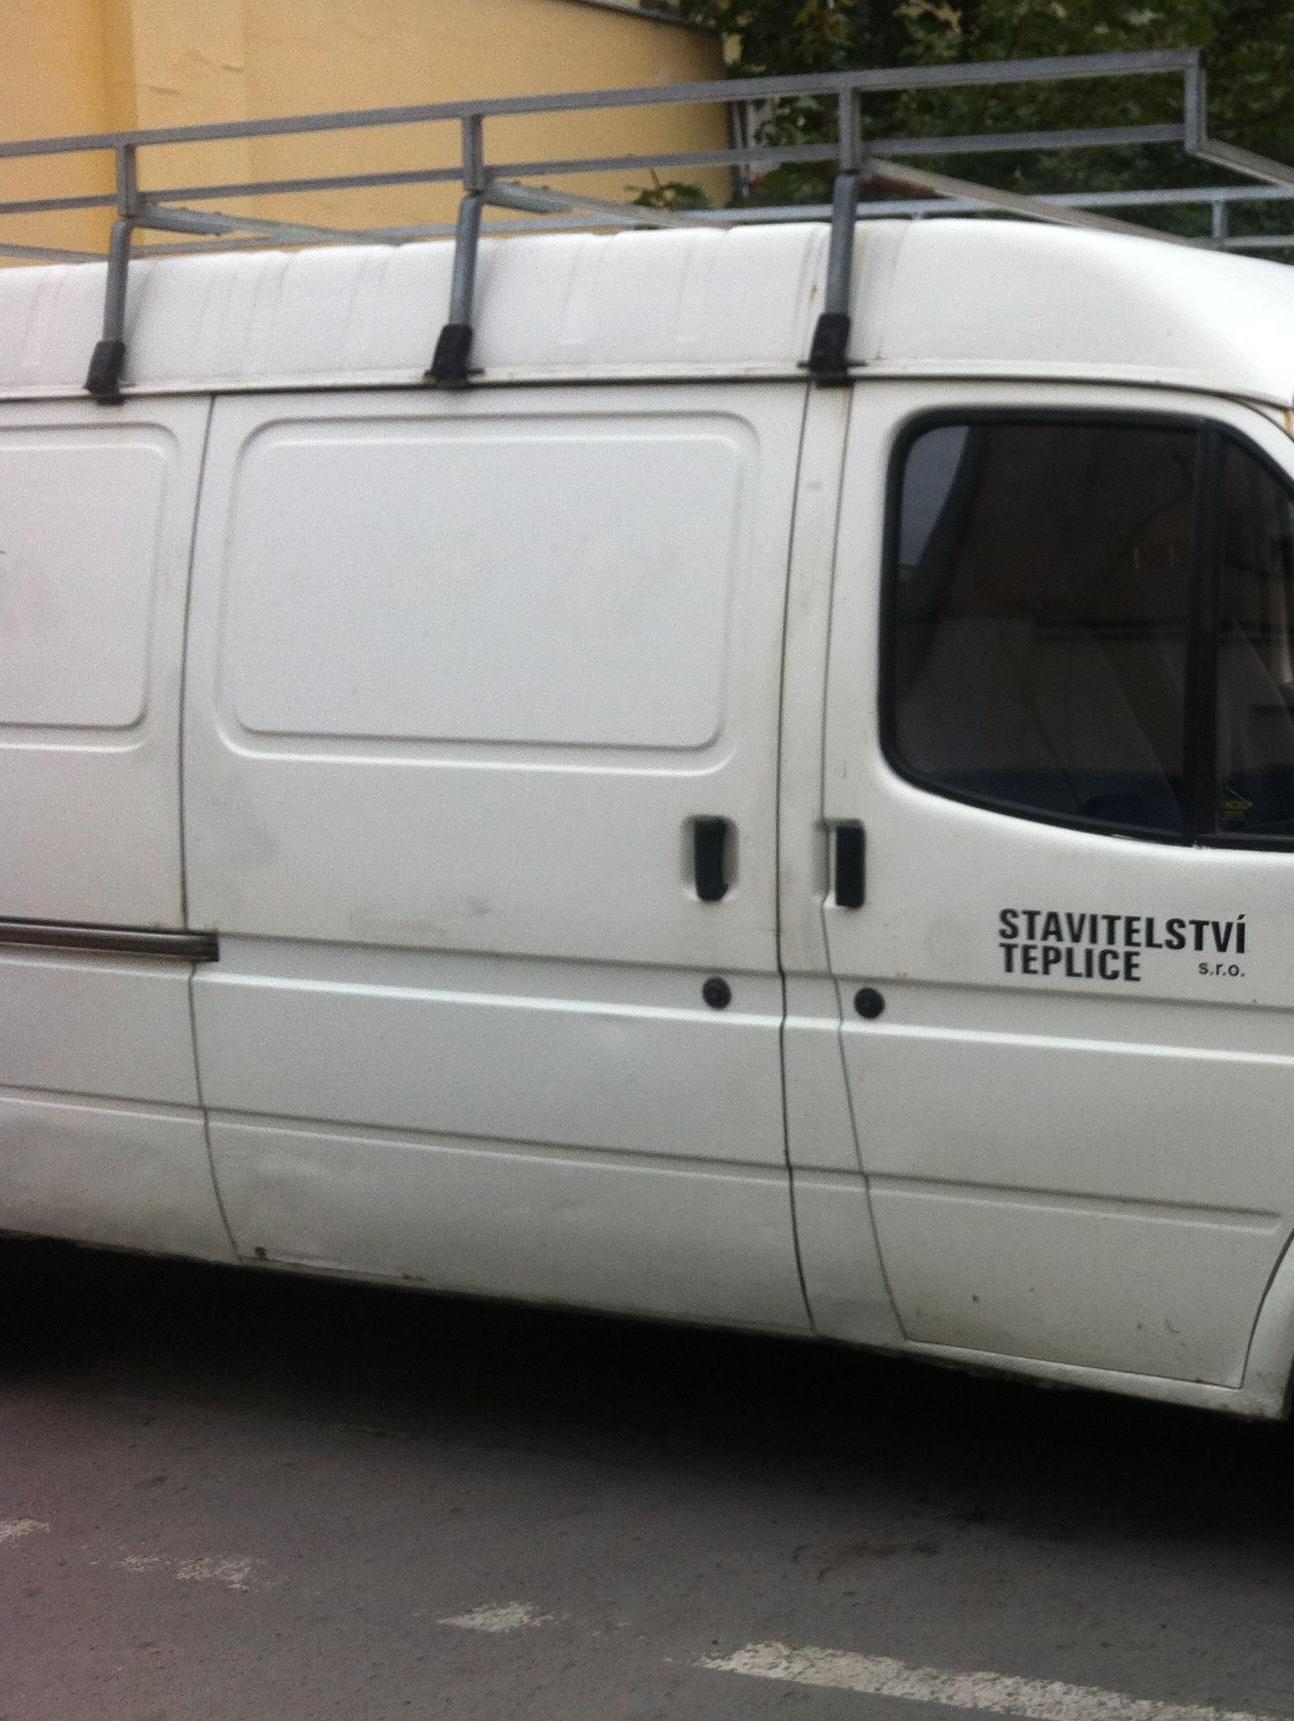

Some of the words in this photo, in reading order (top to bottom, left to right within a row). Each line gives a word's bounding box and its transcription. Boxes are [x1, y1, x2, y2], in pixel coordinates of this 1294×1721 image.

[999, 908, 1246, 954] STAVITELSTVÍ
[999, 943, 1141, 982] TEPLICE
[1198, 961, 1246, 977] s.r.o.
